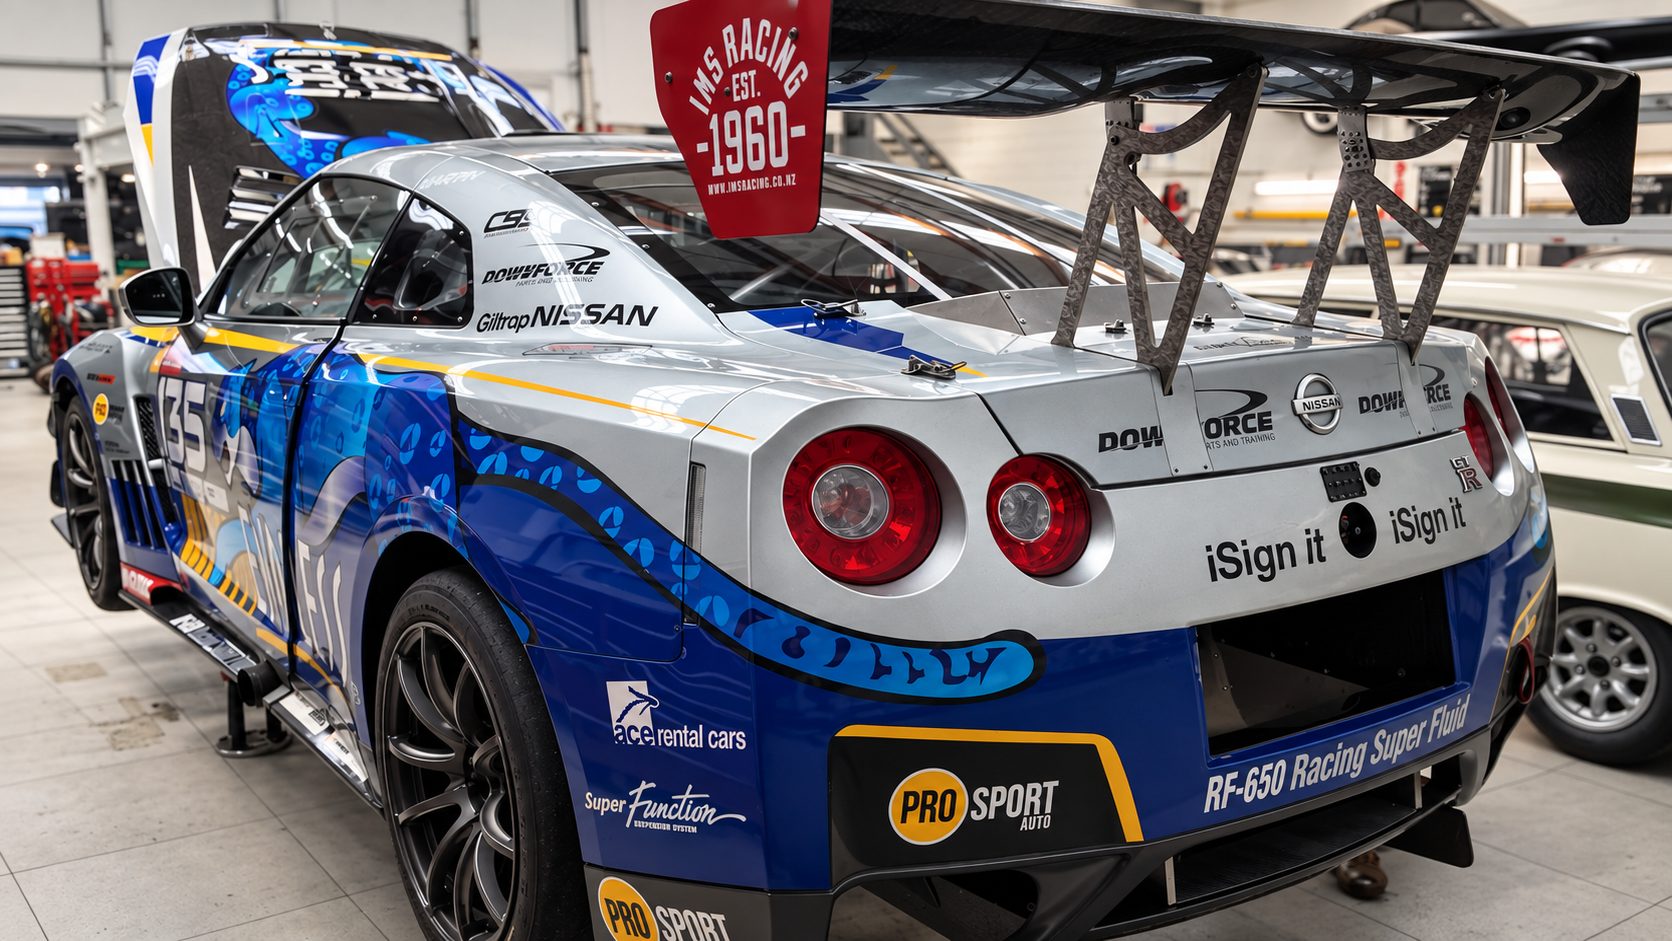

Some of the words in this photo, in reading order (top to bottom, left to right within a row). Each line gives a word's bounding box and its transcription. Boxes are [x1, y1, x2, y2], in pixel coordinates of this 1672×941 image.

[689, 46, 724, 116] IMS
[722, 17, 808, 99] RACING
[732, 69, 760, 102] EST.
[708, 173, 797, 196] WWW.IMSRACING.CO.NZ
[476, 312, 531, 334] Giltrap
[530, 303, 659, 327] NISSAN
[1302, 396, 1341, 412] NISSAN
[1223, 438, 1239, 447] AND
[1240, 432, 1276, 445] TRAINING
[1389, 504, 1449, 545] iSign
[1449, 497, 1466, 529] it
[1205, 539, 1297, 583] iSign
[1304, 528, 1326, 565] it
[614, 723, 655, 746] ace
[657, 724, 703, 748] rental
[708, 730, 747, 750] cars
[1203, 759, 1287, 813] RF-650
[1289, 741, 1367, 790] Racing
[1370, 720, 1428, 765] Super
[1428, 693, 1471, 744] Fluid
[585, 792, 626, 816] Super
[625, 780, 747, 828] Function
[900, 788, 958, 825] PRO
[970, 780, 1060, 821] SPORT
[1019, 814, 1052, 832] AUTO
[604, 897, 651, 940] PRO
[655, 905, 730, 941] SPORT
